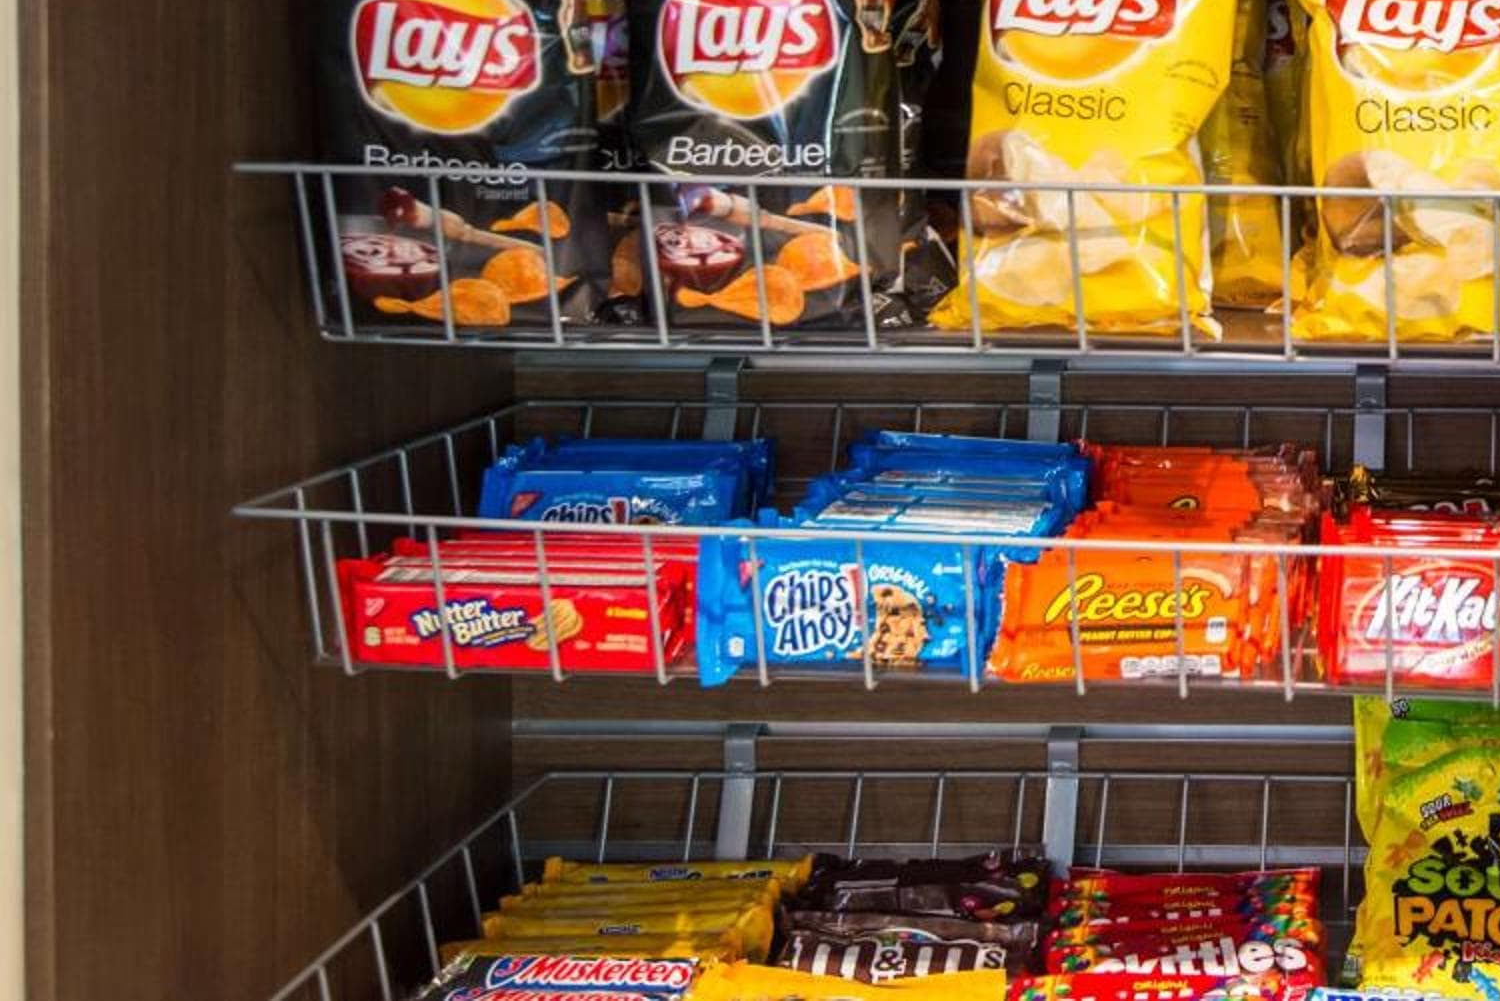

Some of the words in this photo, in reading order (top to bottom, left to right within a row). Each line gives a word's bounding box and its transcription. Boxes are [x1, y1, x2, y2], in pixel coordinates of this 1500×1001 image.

[369, 2, 528, 87] Lay's
[1004, 82, 1127, 122] Classic
[1354, 97, 1493, 134] Classic
[667, 136, 826, 167] Barbecue
[767, 572, 849, 623] Chips
[1045, 574, 1211, 623] Reese's
[453, 609, 524, 645] Butter
[518, 955, 691, 986] Musketeers
